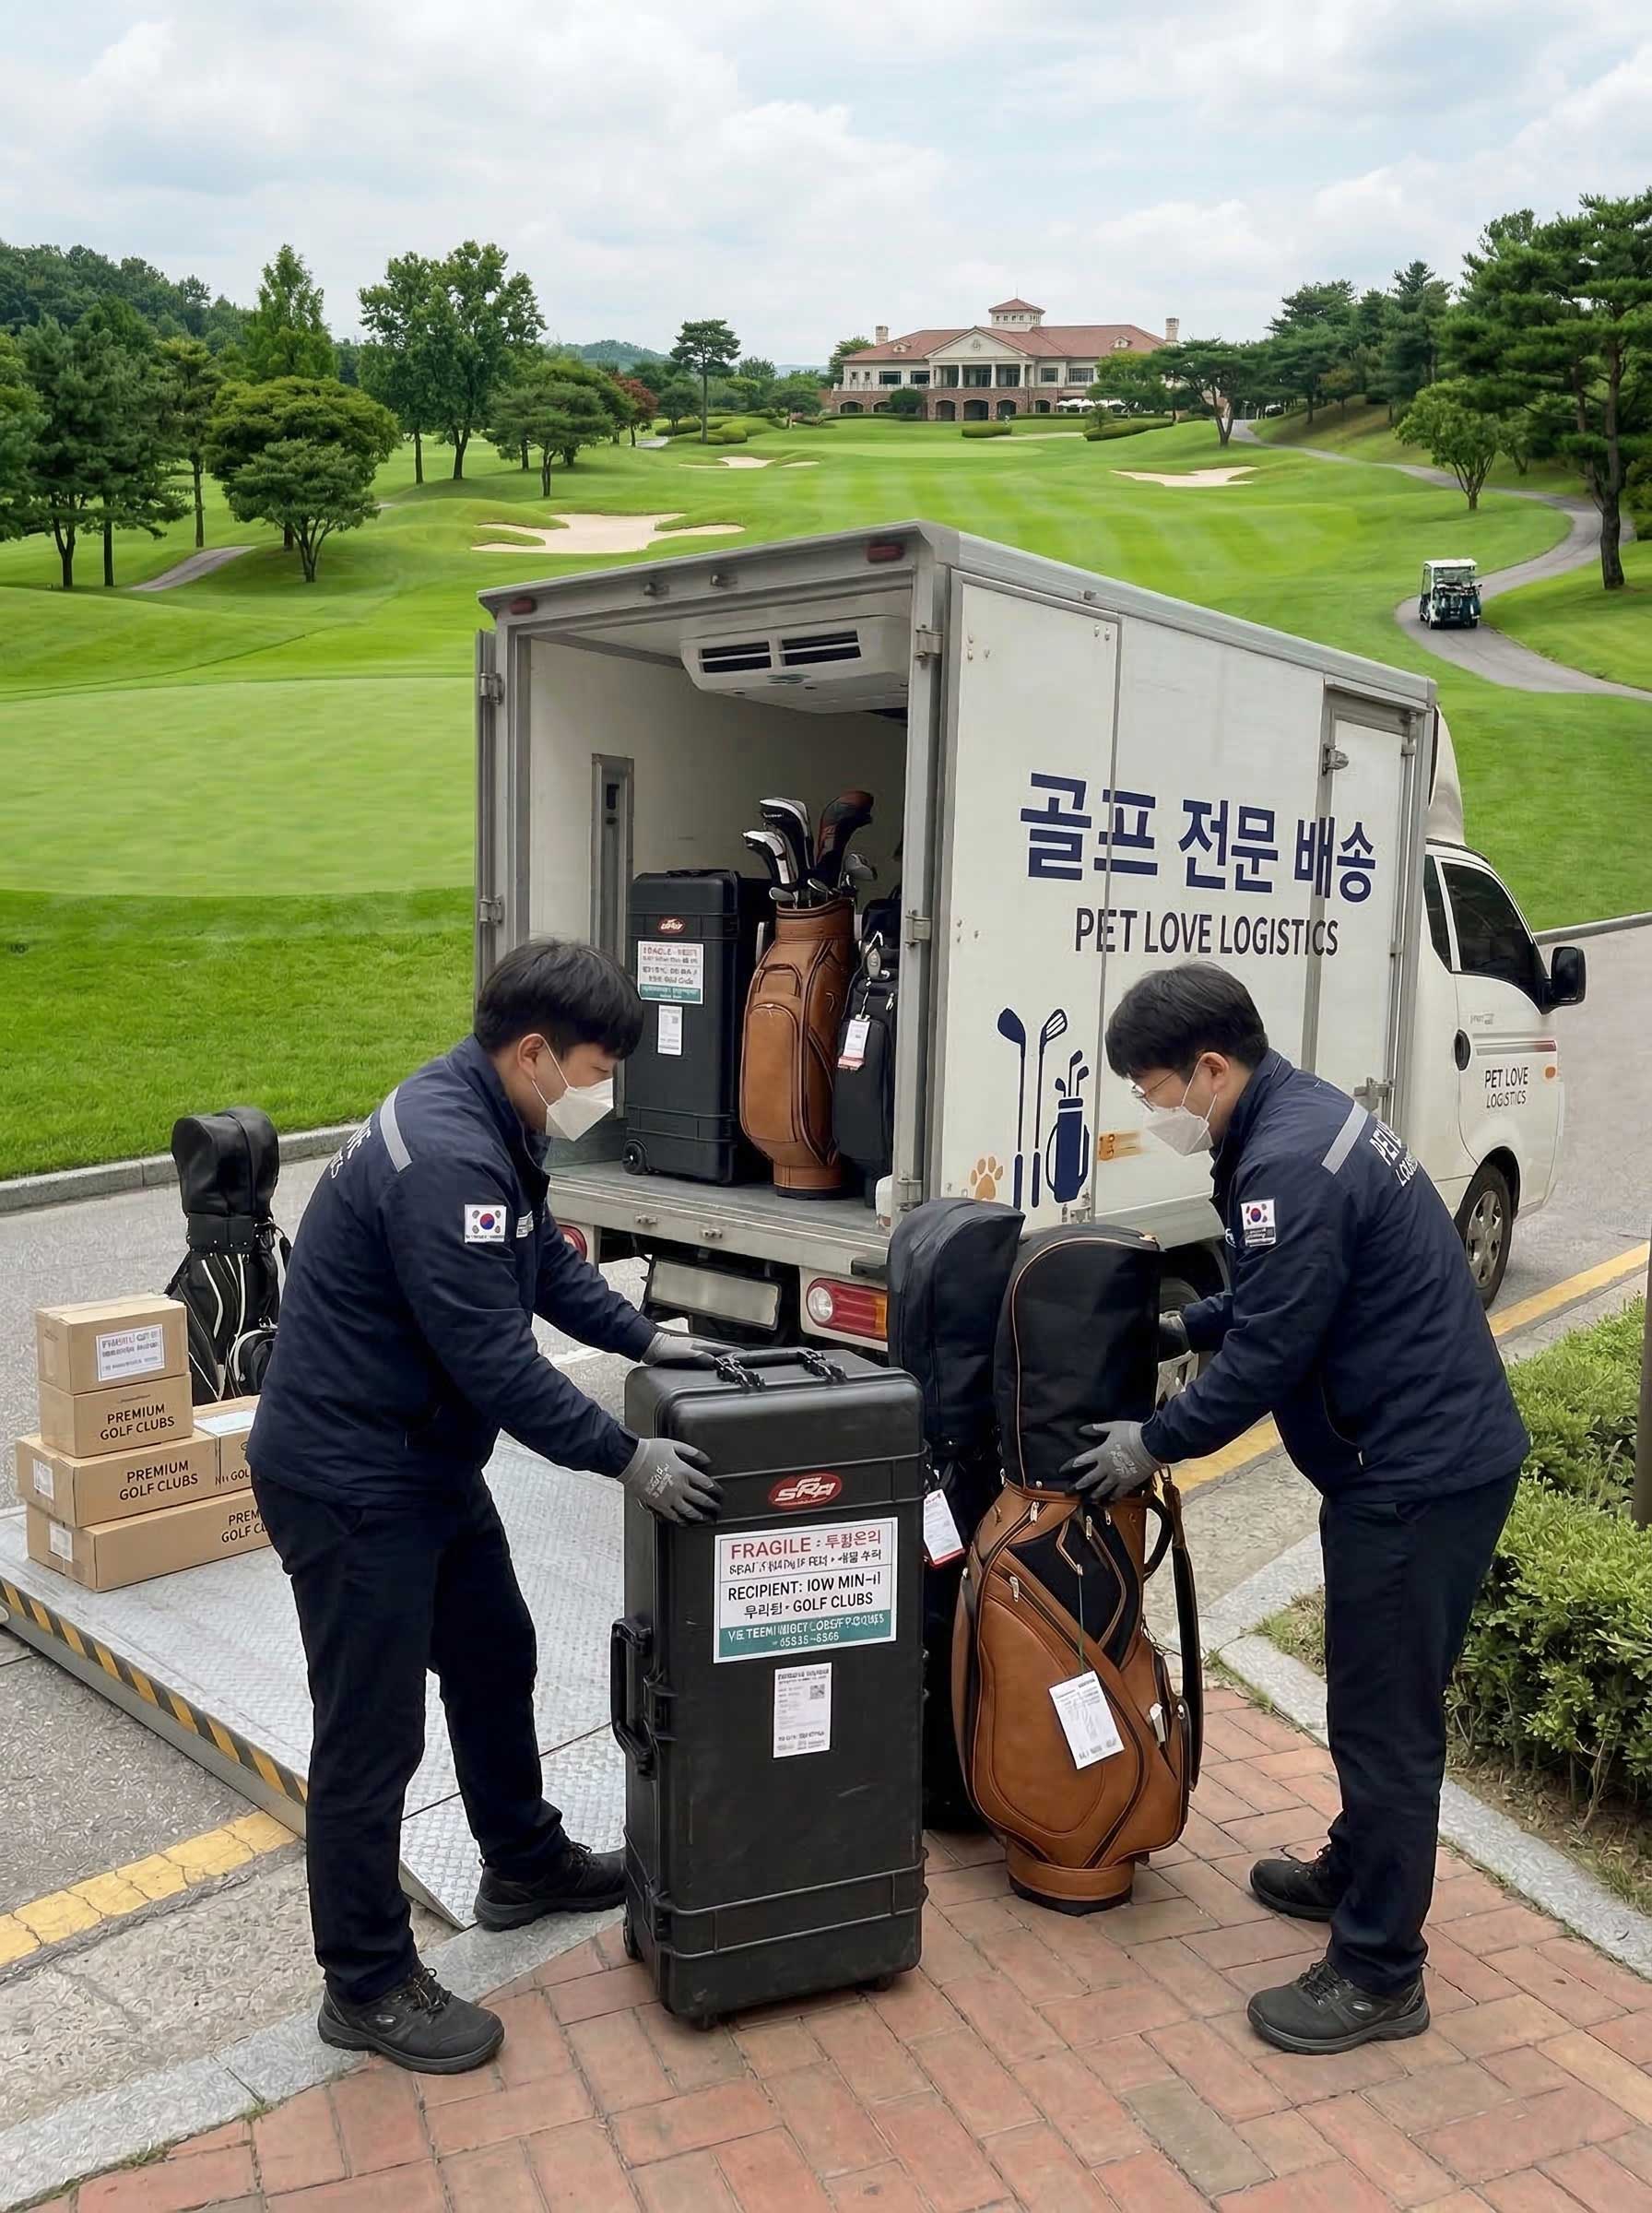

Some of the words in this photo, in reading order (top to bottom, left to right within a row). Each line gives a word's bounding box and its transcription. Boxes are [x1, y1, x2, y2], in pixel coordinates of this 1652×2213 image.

[1020, 772, 1158, 881] 골프
[1177, 799, 1279, 893] 전문
[1293, 815, 1376, 903] 배송
[1075, 906, 1138, 953] PET
[1144, 911, 1212, 953] LOVE
[1220, 916, 1339, 957] LOGISTICS
[1485, 1069, 1504, 1089] PET
[1505, 1067, 1528, 1086] LOVE
[107, 1403, 165, 1425] PREMIUM
[100, 1423, 134, 1440] GOLF
[136, 1415, 175, 1433] CLUBS
[126, 1460, 189, 1484] PREMIUM
[119, 1483, 155, 1501] GOLF
[158, 1473, 198, 1492] CLUBS
[221, 1524, 251, 1544] GOLF
[731, 1536, 811, 1560] FRAGILE
[728, 1580, 803, 1601] RECIPIENT:
[793, 1596, 828, 1613] GOLF
[831, 1592, 873, 1608] CLUBS
